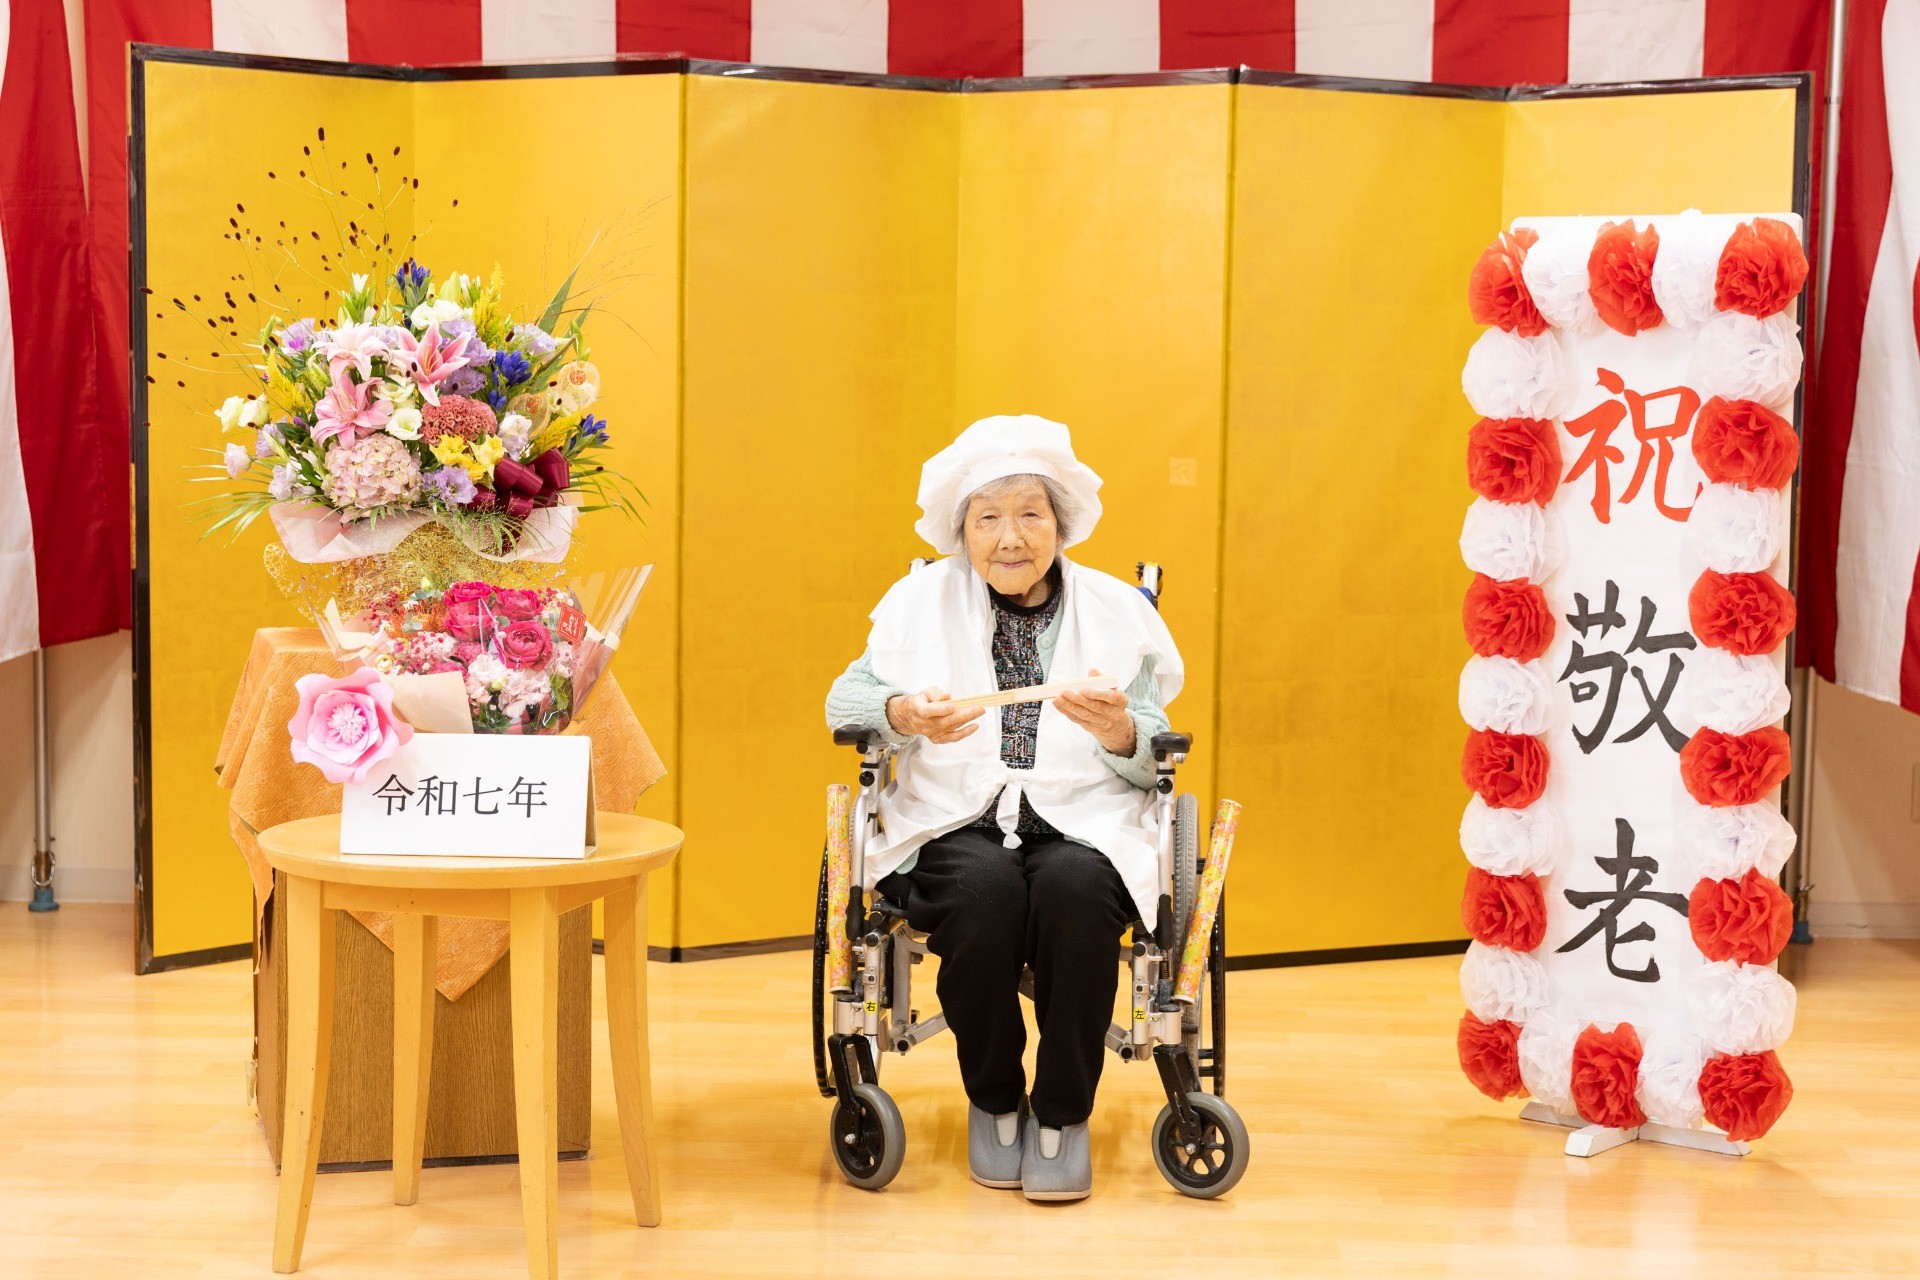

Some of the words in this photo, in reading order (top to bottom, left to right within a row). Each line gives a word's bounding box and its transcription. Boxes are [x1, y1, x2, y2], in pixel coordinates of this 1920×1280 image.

[1554, 367, 1703, 983] 祝敬老
[372, 773, 548, 818] 令和七年
[866, 1001, 876, 1012] 右
[1134, 1009, 1145, 1020] 左
